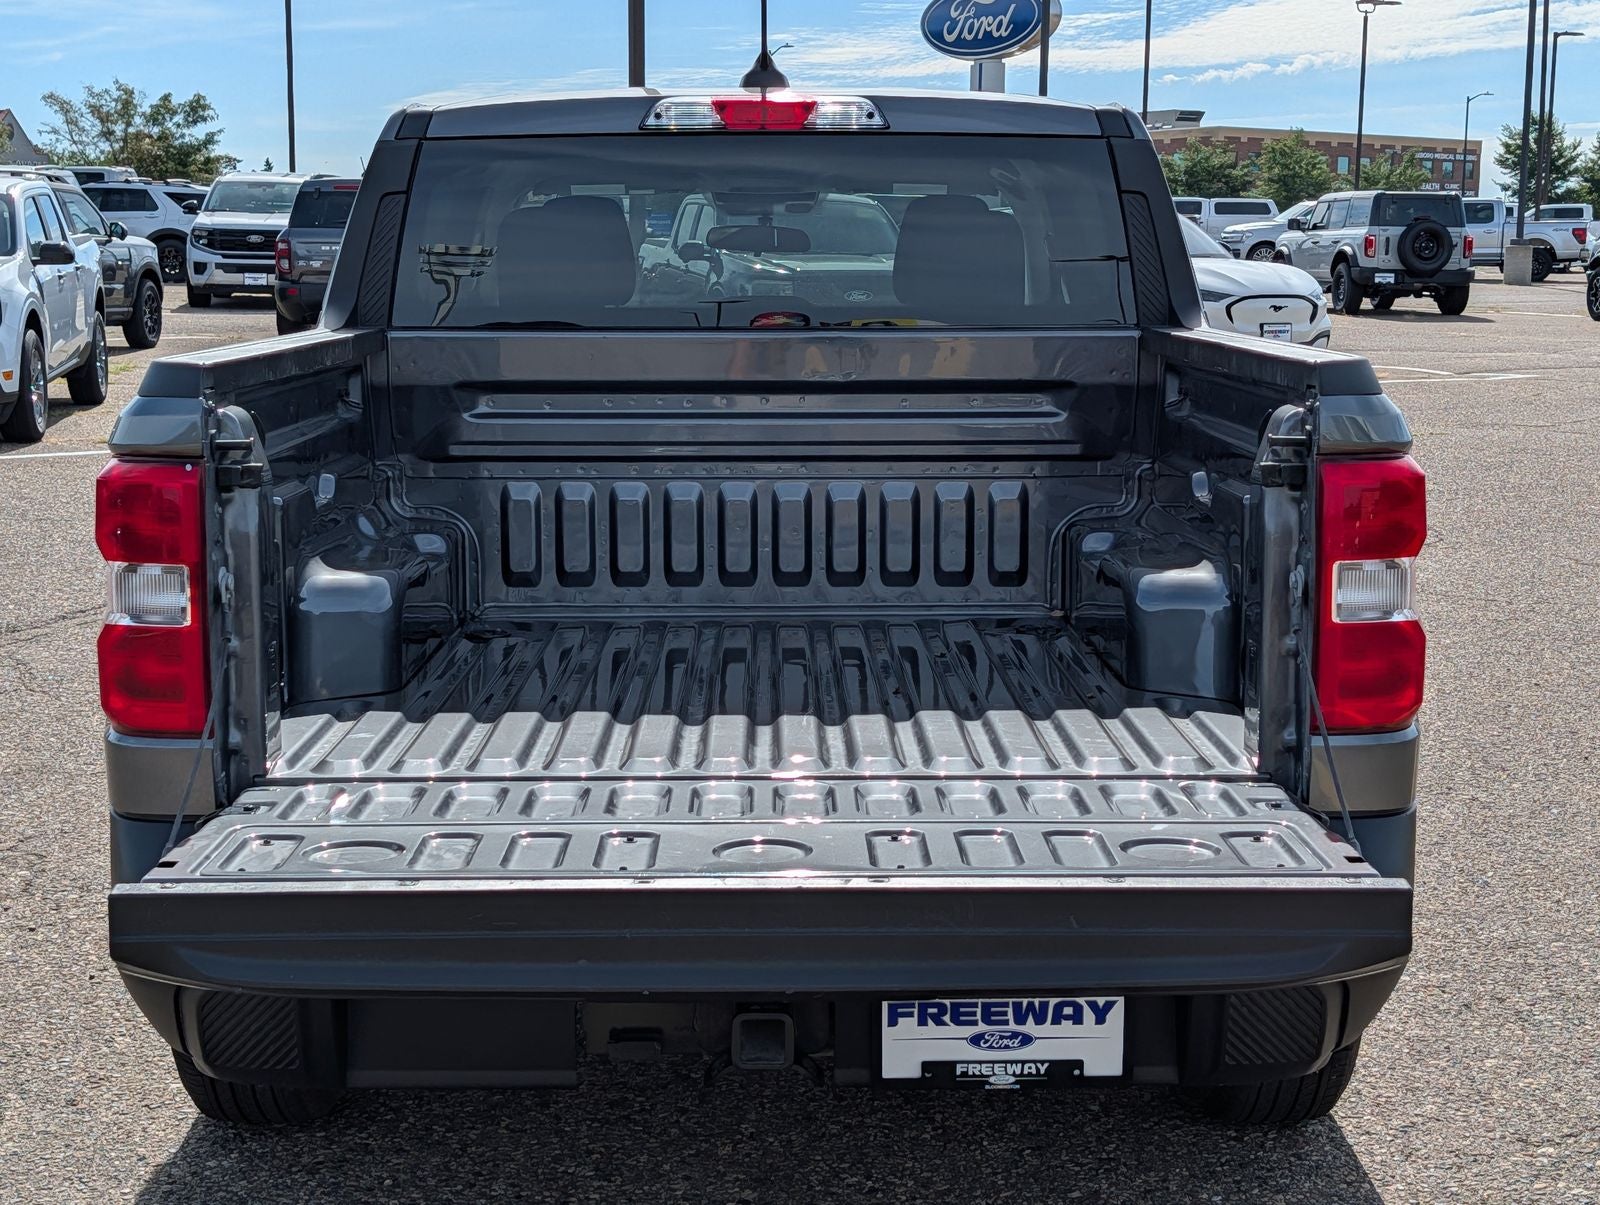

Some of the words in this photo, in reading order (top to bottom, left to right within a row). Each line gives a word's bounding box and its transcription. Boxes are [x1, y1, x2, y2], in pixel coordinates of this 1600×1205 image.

[943, 0, 1017, 43] Ford
[887, 999, 1119, 1027] FREEWAY
[980, 1031, 1022, 1048] Ford
[956, 1062, 1050, 1076] FREEWAY
[993, 1075, 1011, 1083] Ford
